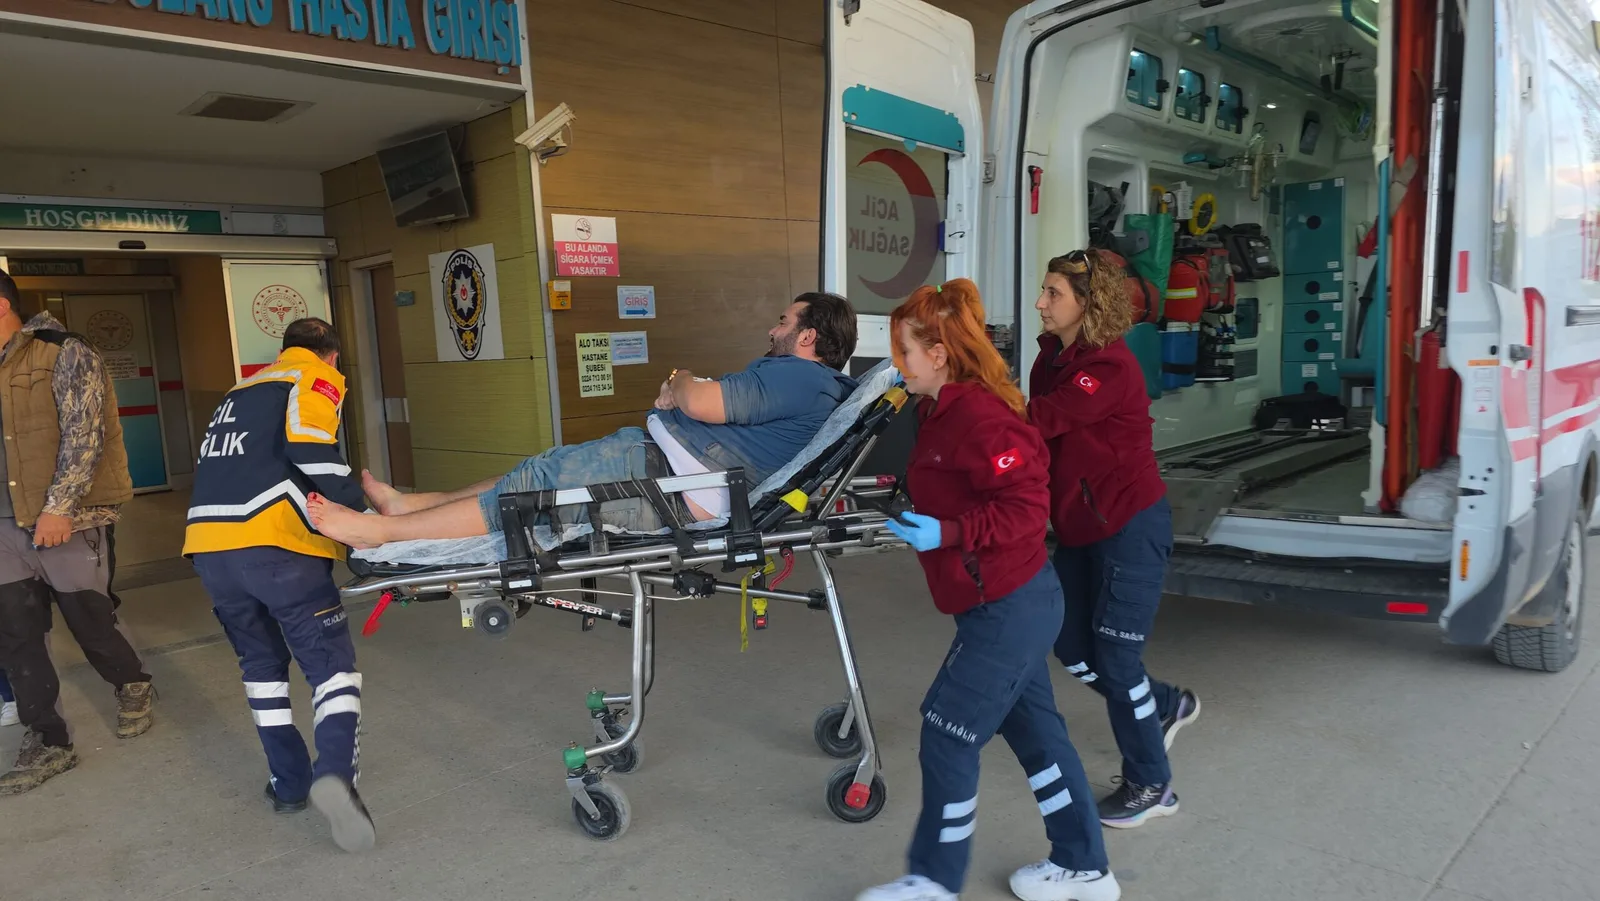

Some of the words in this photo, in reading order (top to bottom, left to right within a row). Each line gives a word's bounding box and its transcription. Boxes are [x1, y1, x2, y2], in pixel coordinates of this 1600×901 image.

[24, 208, 190, 231] HOŞGELDİNİZ
[565, 243, 577, 252] BU
[577, 244, 608, 253] ALANDA
[451, 255, 474, 272] POLİS
[560, 253, 590, 264] SİGARA
[590, 254, 614, 266] İÇMEK
[570, 266, 607, 275] YASAKTIR
[625, 296, 649, 307] GİRİŞ
[579, 339, 591, 348] ALO
[582, 352, 608, 361] HASTANE
[545, 597, 603, 615] SPENCER
